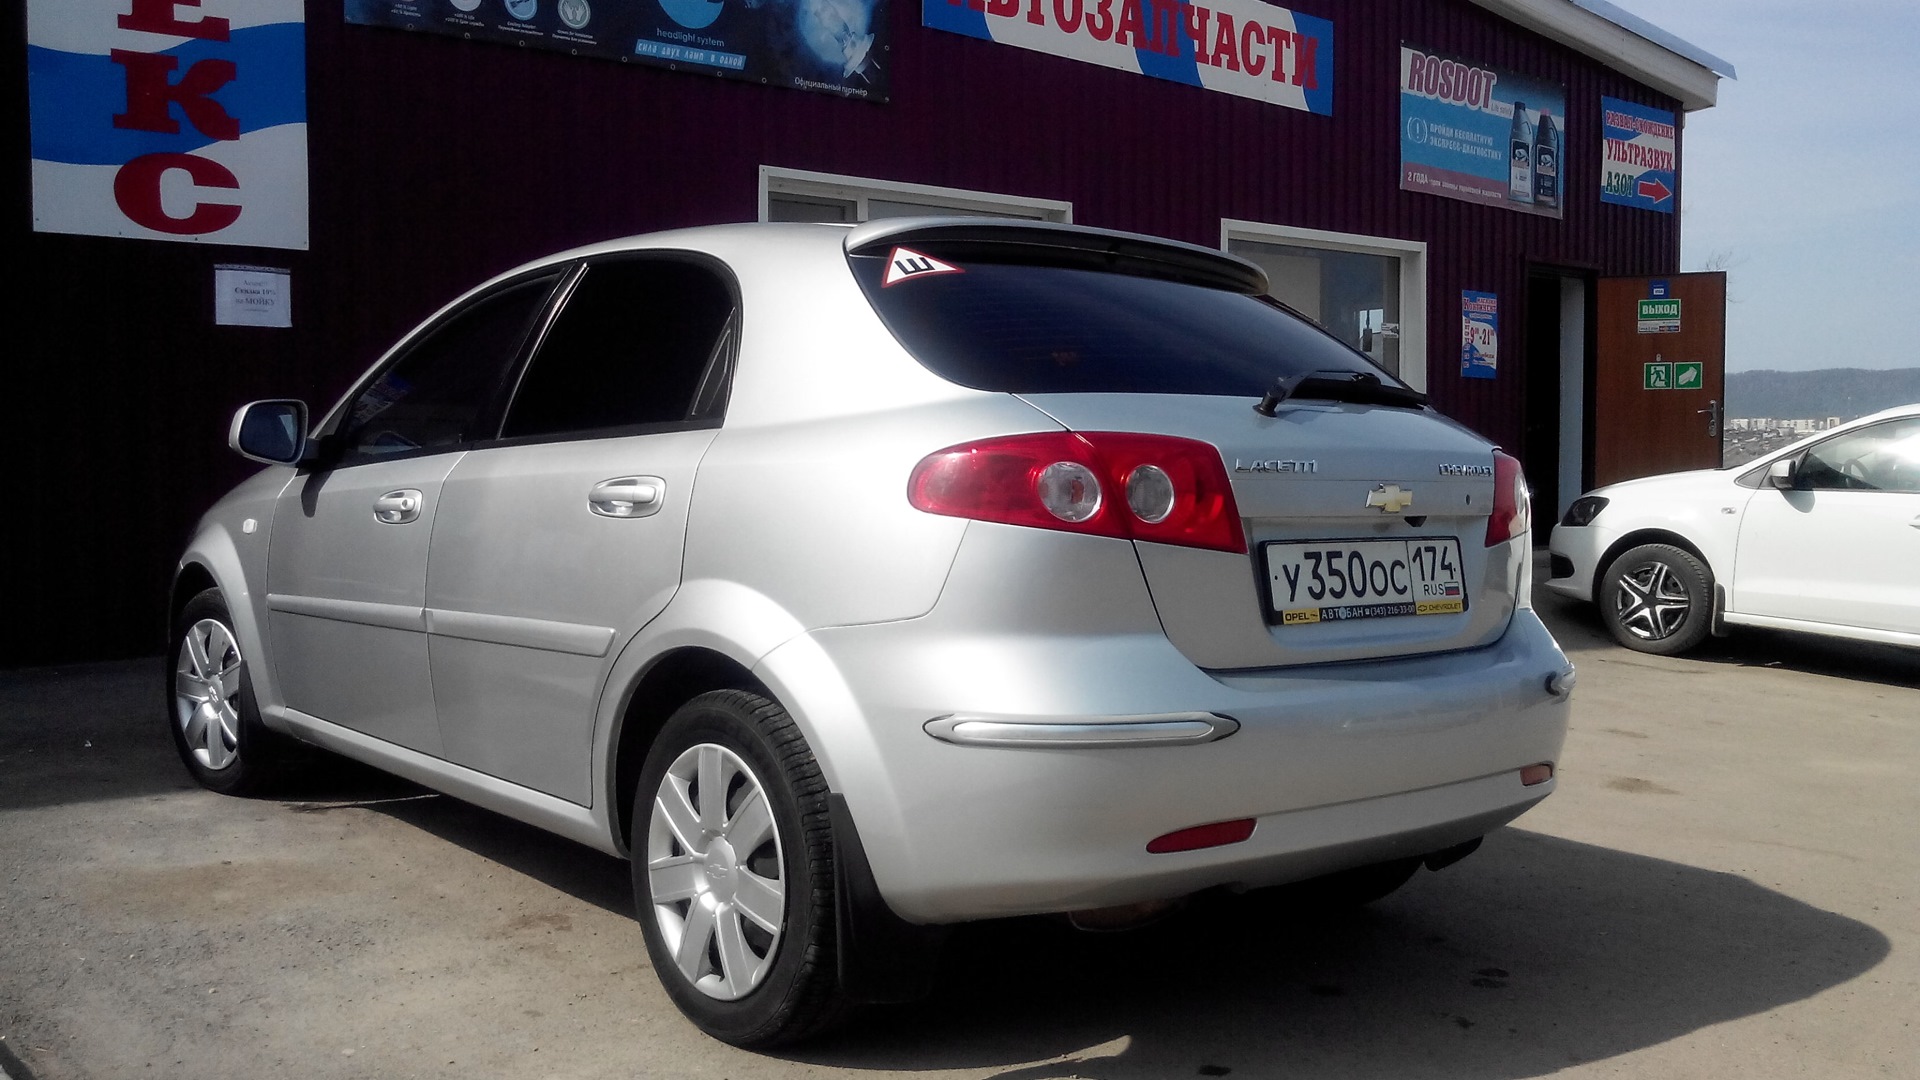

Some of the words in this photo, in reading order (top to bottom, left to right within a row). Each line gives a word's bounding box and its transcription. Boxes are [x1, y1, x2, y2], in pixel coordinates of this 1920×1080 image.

[656, 27, 695, 43] headlight
[697, 36, 725, 47] system
[943, 0, 1319, 90] ОЗАПЧАСТИ
[794, 77, 841, 92] Официальный
[1408, 52, 1496, 109] ROSDOT
[1606, 138, 1673, 173] УЛЬТРАЗВУК
[1407, 171, 1413, 182] 2
[1413, 172, 1429, 185] ГОДА
[1604, 170, 1635, 198] АЗОТ
[895, 257, 935, 275] Ш
[1642, 304, 1678, 315] ВЫХОД
[1235, 458, 1318, 474] LACETTI
[1438, 463, 1493, 477] CHEVROLET
[1412, 546, 1454, 581] 174
[1423, 583, 1445, 597] RUS
[1321, 606, 1364, 620] АВТОБАН
[1370, 606, 1387, 617] (343)
[1428, 602, 1461, 612] CHEVROLET
[1285, 611, 1310, 622] OPEL
